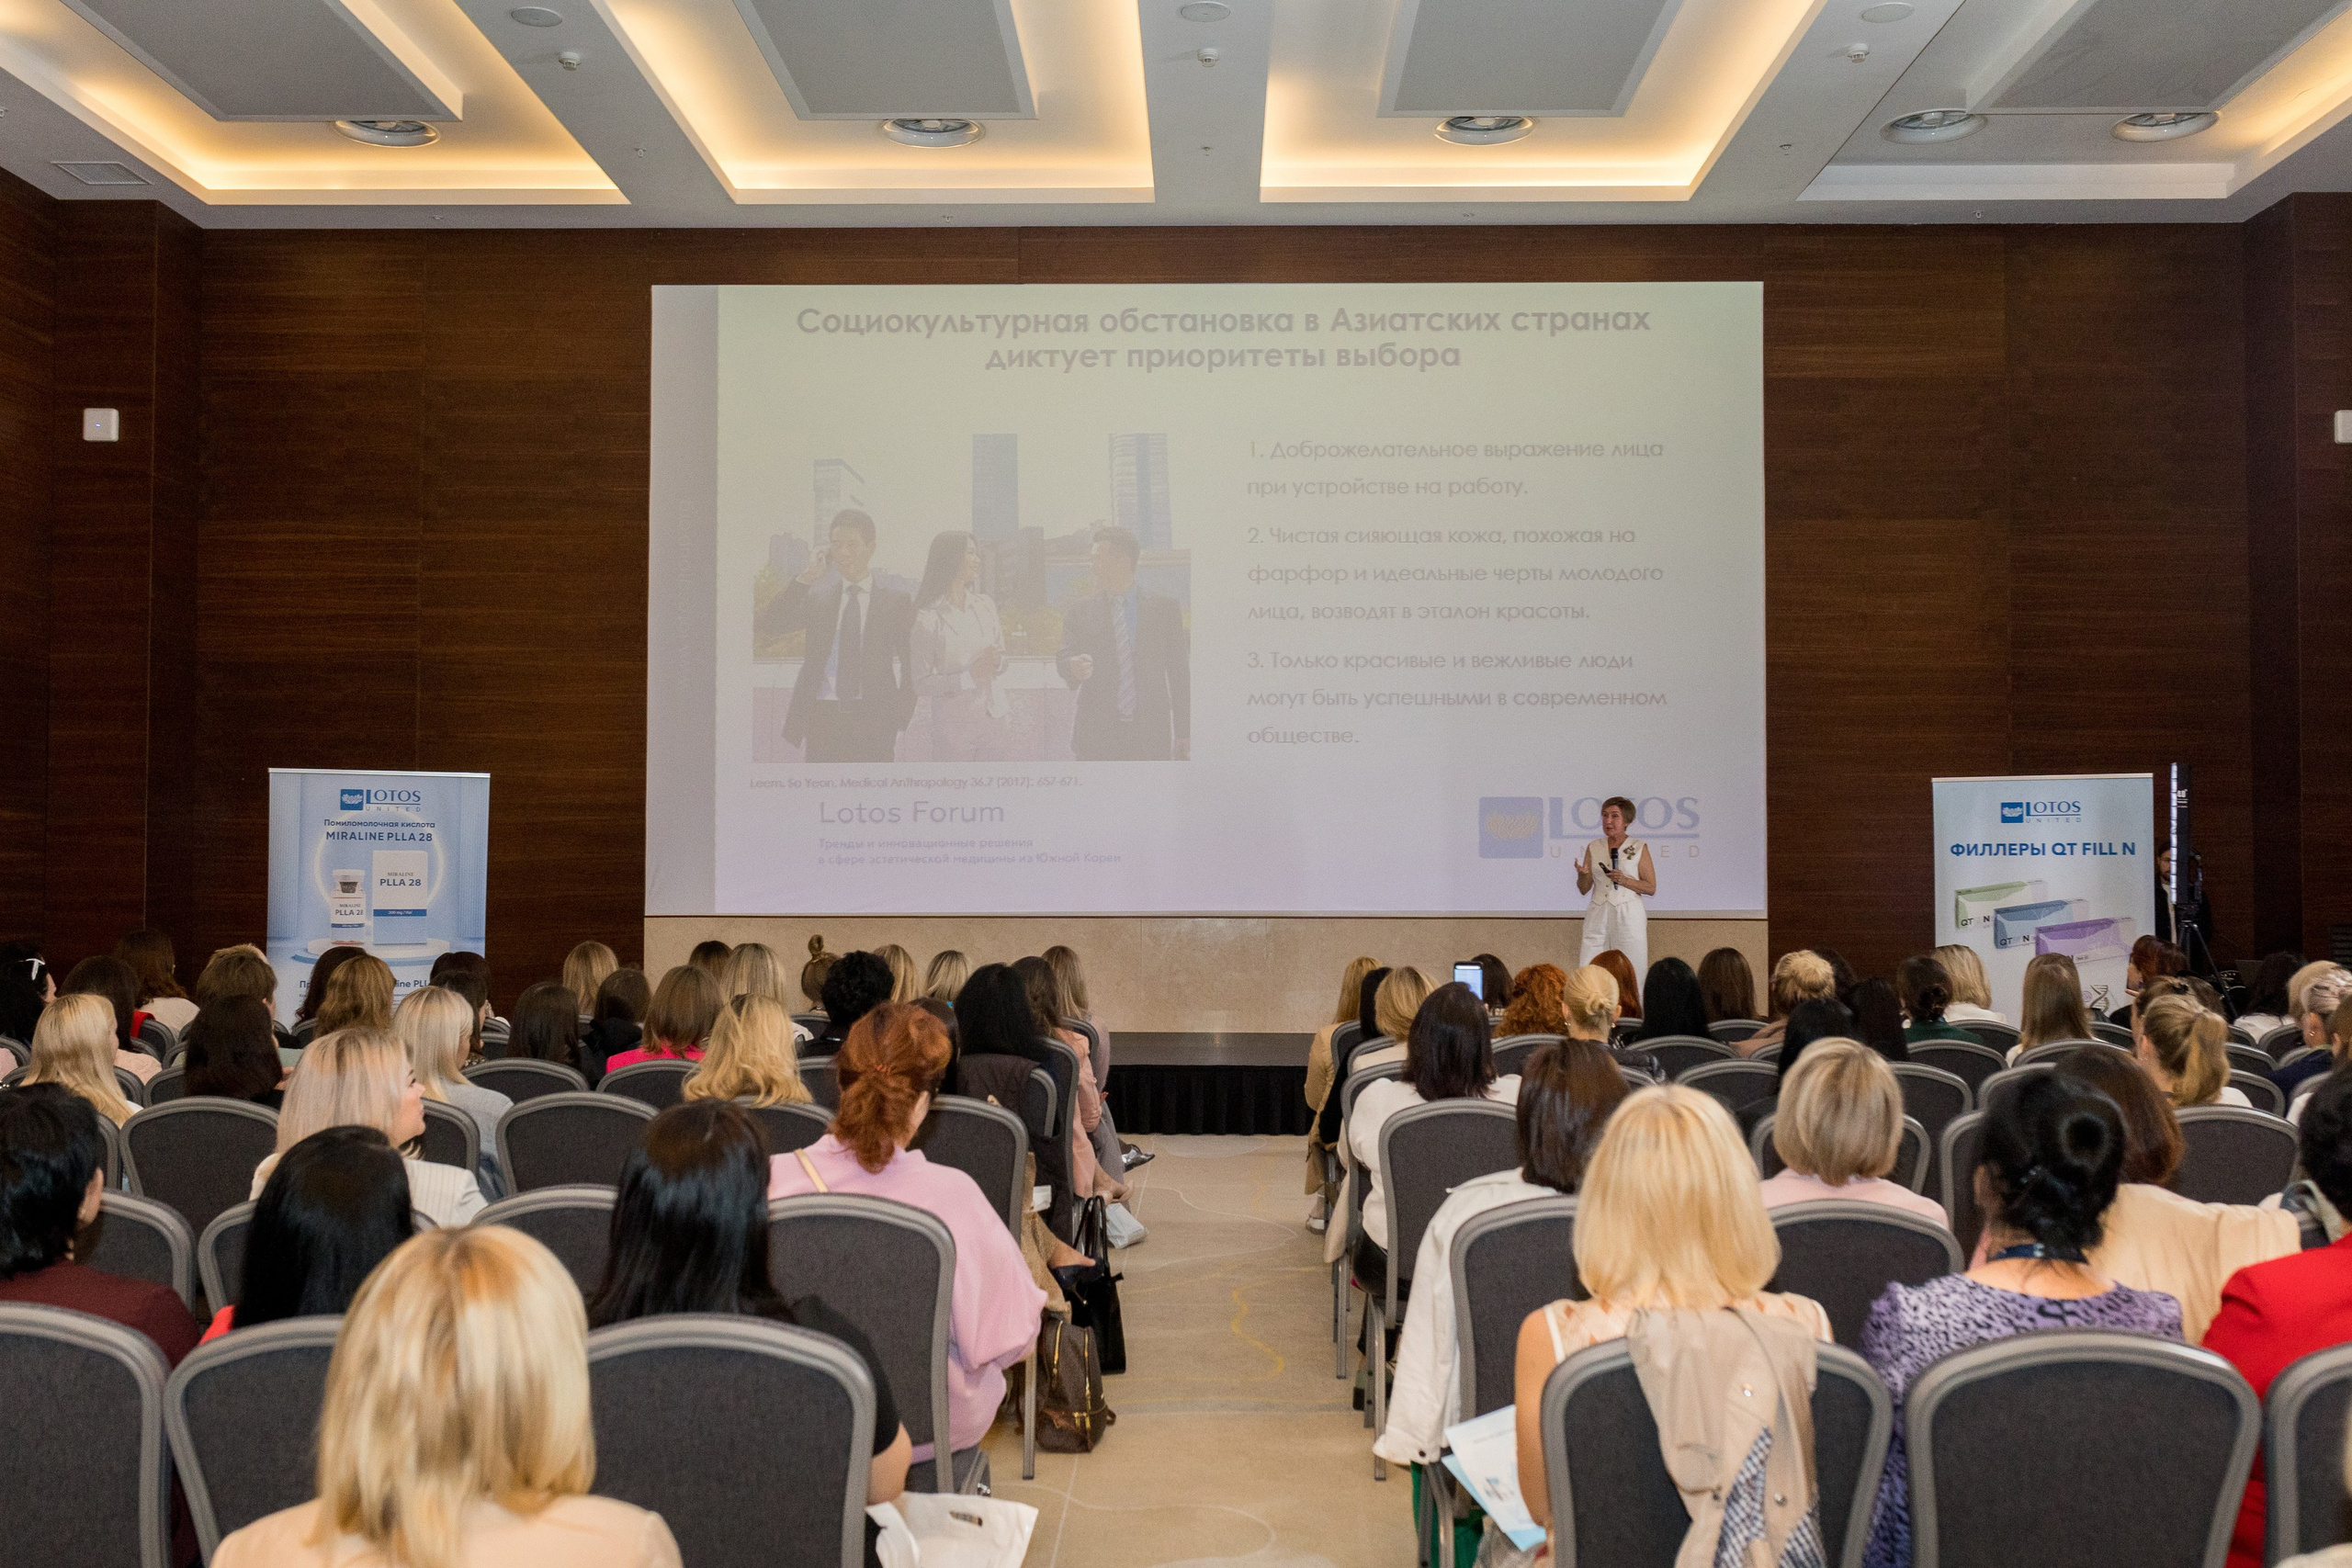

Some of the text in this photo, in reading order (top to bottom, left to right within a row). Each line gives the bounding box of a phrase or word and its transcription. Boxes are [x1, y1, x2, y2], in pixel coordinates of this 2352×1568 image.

[797, 308, 1651, 339] Социокультурная обстановка в Азиатских странах
[985, 343, 1461, 374] диктует приоритеты выбора
[1250, 440, 1664, 461] 1. Доброжелательное выражение лица
[1247, 477, 1528, 499] при устройстве на работу.
[1247, 526, 1636, 545] 2. Чистая сияющая кожа, похожая на
[1247, 564, 1665, 585] фарфор и идеальные черты молодого
[1248, 605, 1590, 623] лица, возводят в эталон красоты.
[1247, 651, 1634, 672] 3. Только красивые и вежливые люди
[1246, 689, 1668, 709] могут быть успешными в современном
[1247, 726, 1360, 745] обществе.
[366, 789, 421, 805] LOTOS
[820, 800, 1004, 824] Lotos Forum
[1549, 795, 1700, 839] LOOS
[2025, 800, 2082, 817] LOTOS
[401, 820, 435, 829] кислота
[325, 830, 433, 842] MIRALINE PLLA 28
[819, 838, 1034, 851] Тренды и инновационные решения
[1950, 841, 2136, 856] ФИЛЛЕРЫ QT FILL N
[818, 852, 1122, 866] в сфере эстетической медицины из Южной Кореи
[379, 878, 422, 886] PLLA 28
[1960, 917, 1974, 927] QT
[1983, 915, 1991, 923] N
[1999, 934, 2030, 946] QT N
